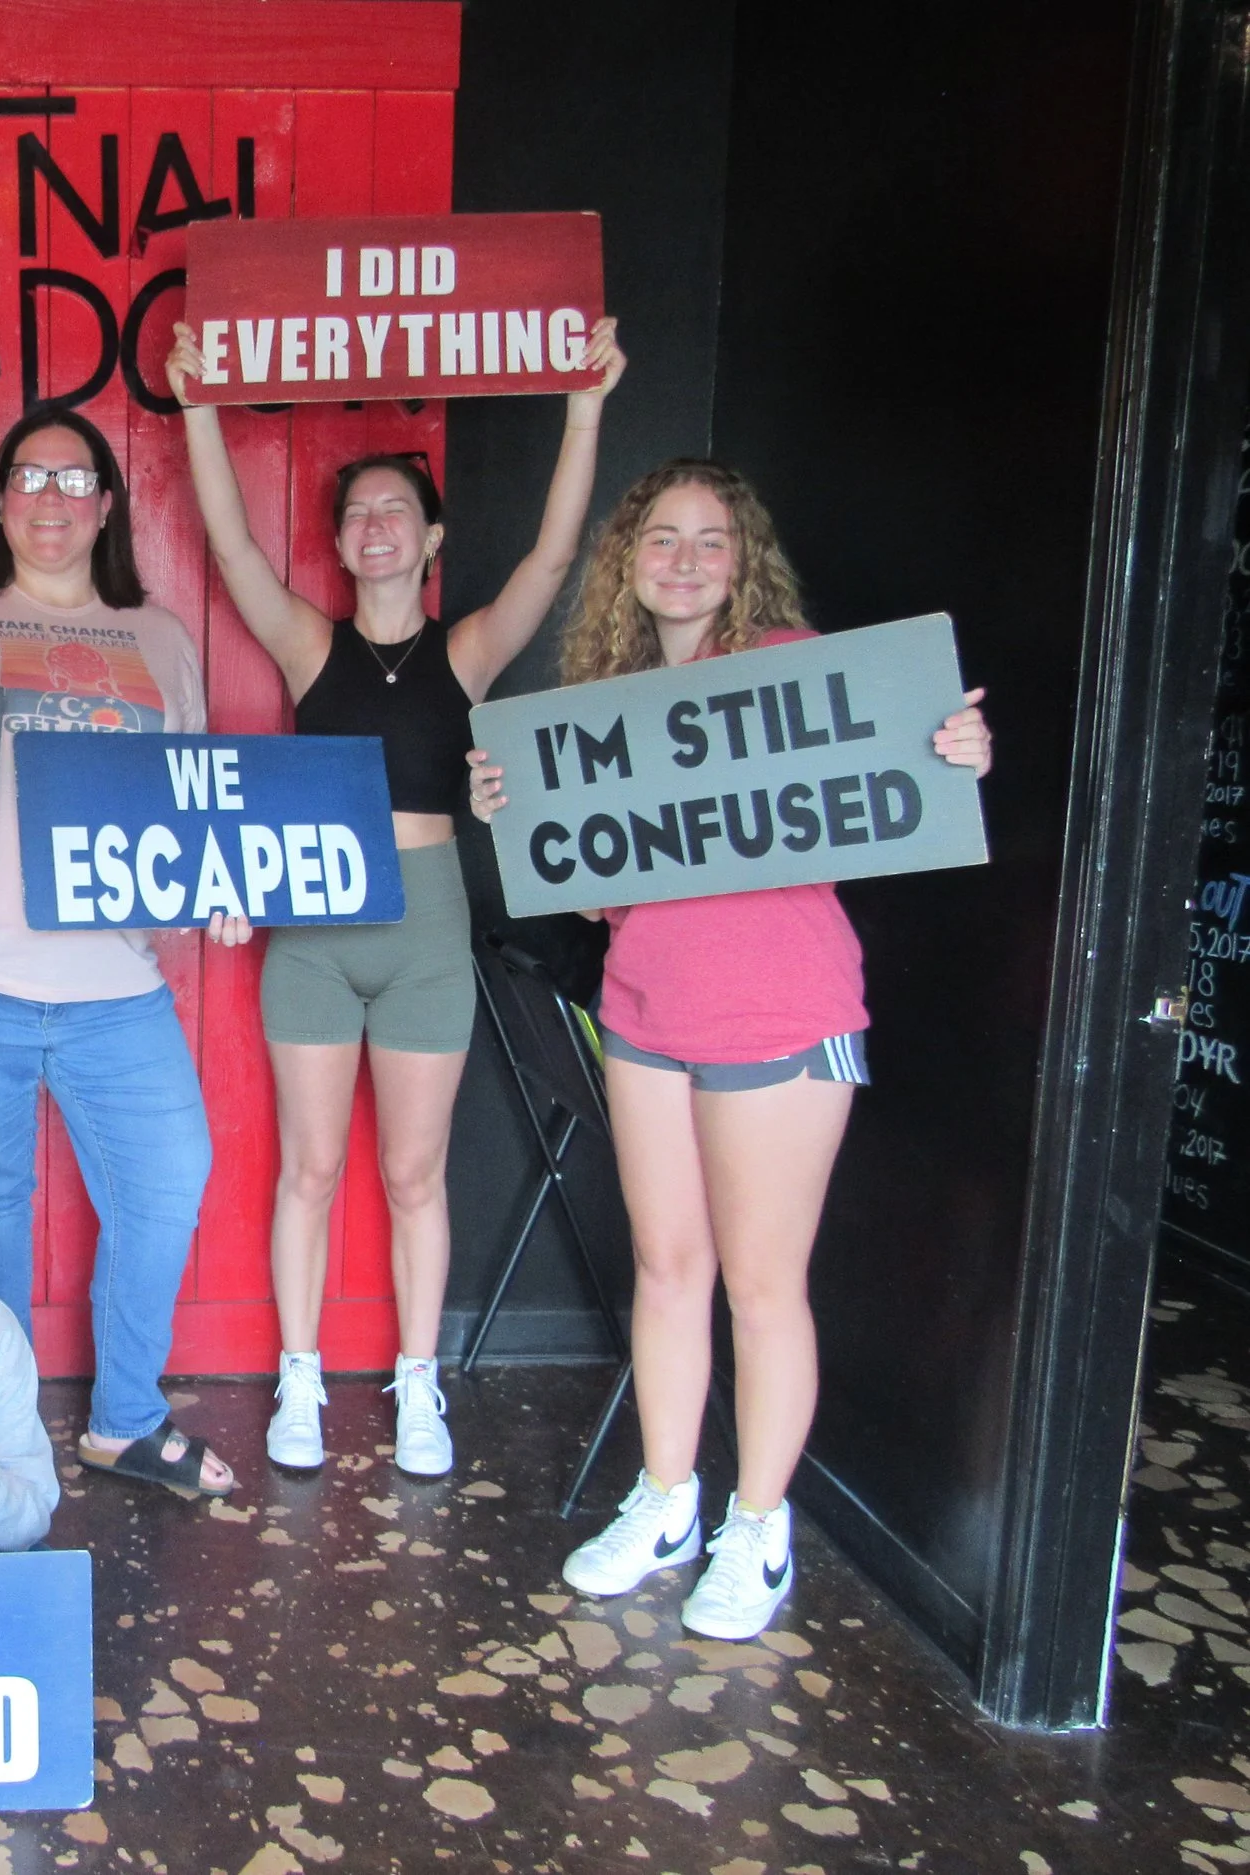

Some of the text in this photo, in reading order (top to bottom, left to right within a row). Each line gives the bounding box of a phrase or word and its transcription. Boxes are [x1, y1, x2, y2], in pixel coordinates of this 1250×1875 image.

[327, 247, 455, 297] I DID
[200, 308, 588, 384] EVERYTHING
[0, 630, 139, 649] MAKE MISTAKES
[50, 625, 136, 640] CHANCES
[535, 672, 876, 790] I'M STILL
[166, 749, 244, 810] WE
[530, 769, 922, 884] CONFUSED
[52, 825, 367, 922] ESCAPED
